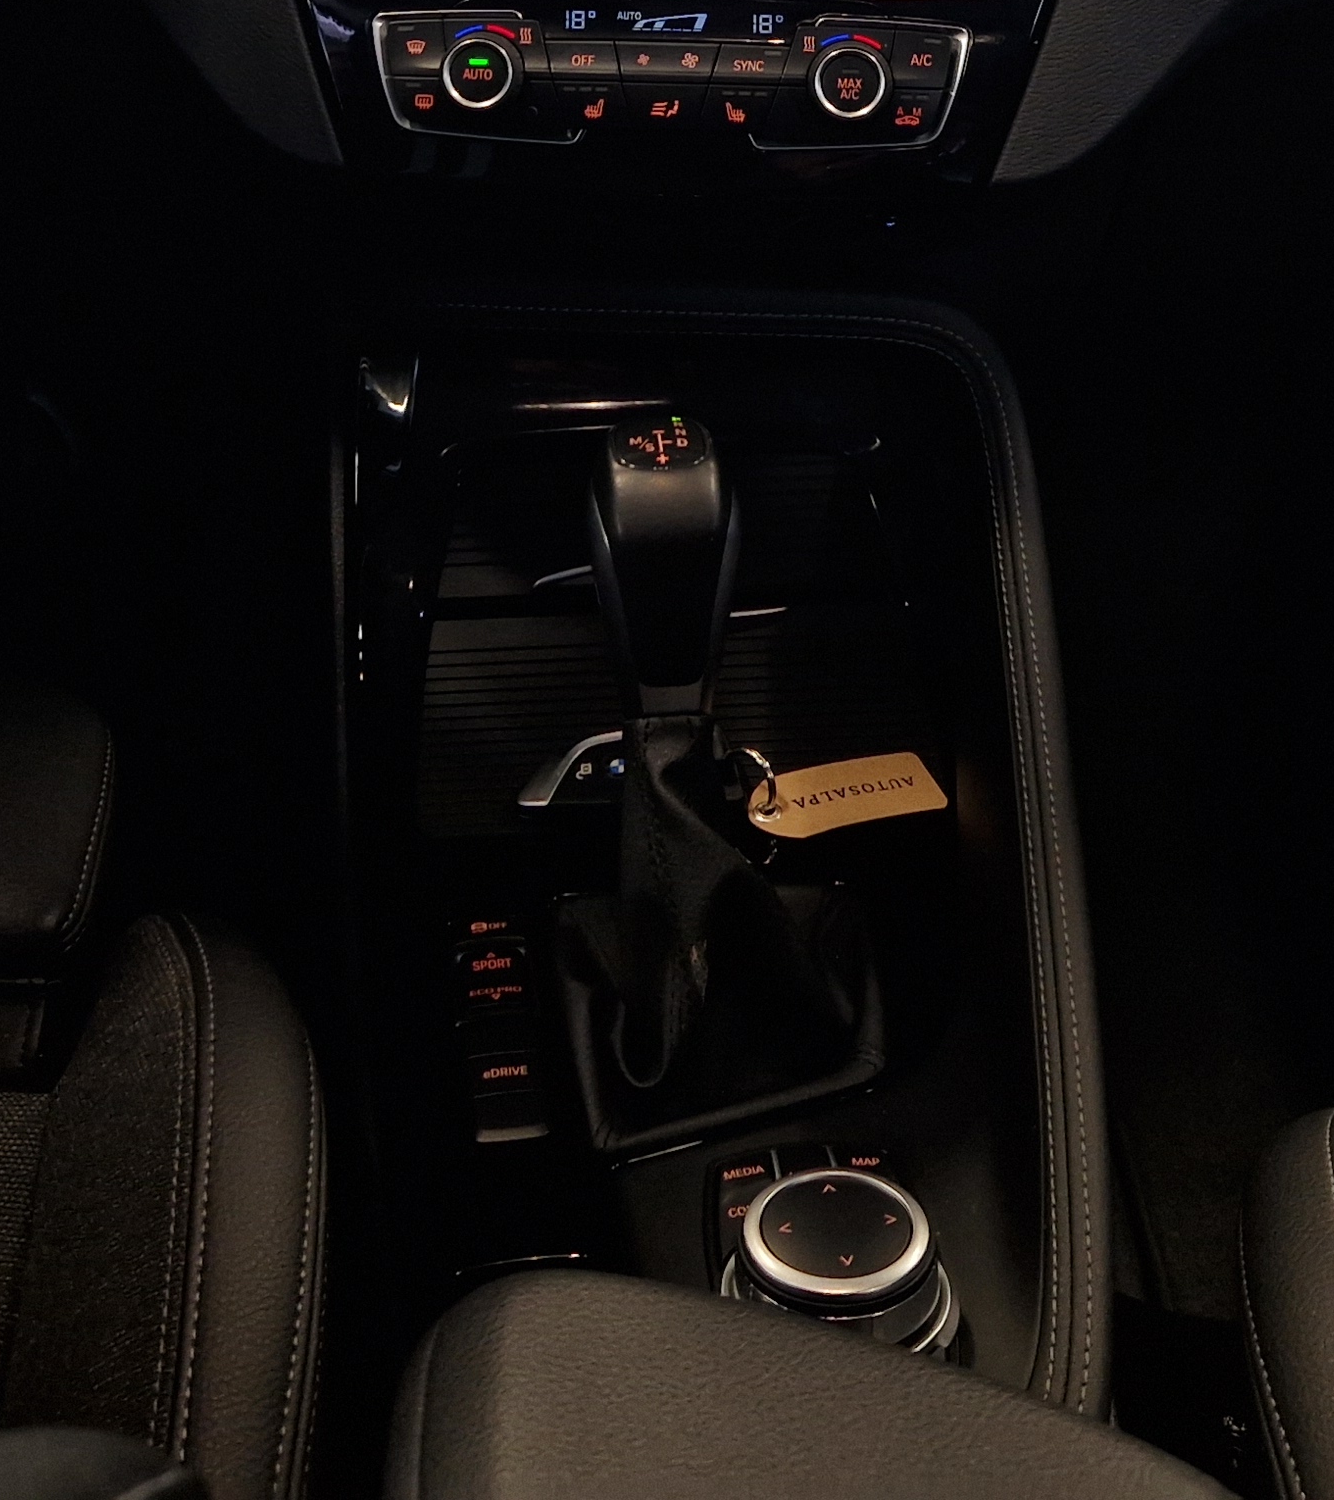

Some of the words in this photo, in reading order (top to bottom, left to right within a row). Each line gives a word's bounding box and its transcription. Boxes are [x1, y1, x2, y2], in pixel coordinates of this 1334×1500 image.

[617, 11, 642, 21] AUTO
[571, 55, 595, 67] OFF
[733, 59, 765, 73] SYNC
[910, 54, 933, 67] A/C
[463, 68, 493, 81] AUTO
[837, 77, 862, 89] MAX
[840, 88, 860, 100] A/C
[896, 106, 905, 116] A
[912, 107, 922, 117] M
[675, 428, 687, 436] N
[676, 438, 688, 447] D
[792, 776, 914, 809] AUTOSALPA
[472, 957, 512, 971] SPORT
[482, 1065, 529, 1079] eDRIVE
[851, 1157, 880, 1167] MAP
[722, 1164, 766, 1181] MEDIA
[727, 1204, 751, 1218] CO
